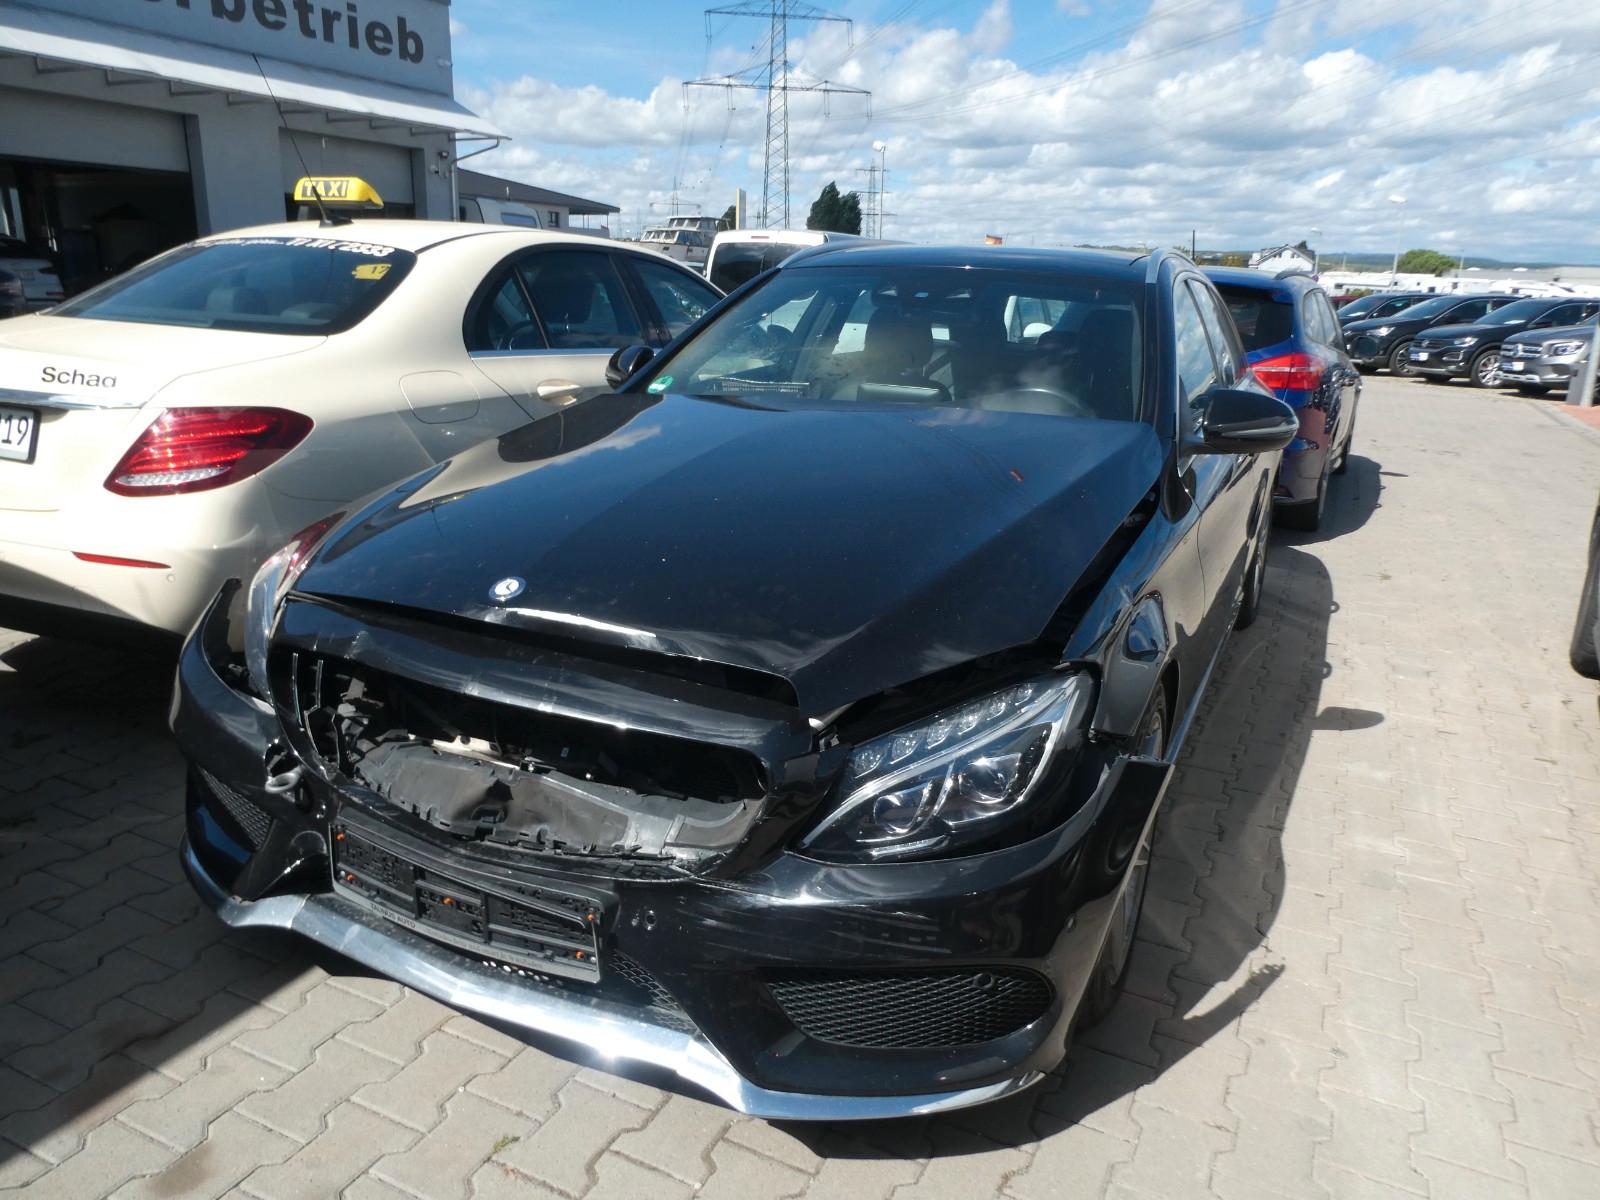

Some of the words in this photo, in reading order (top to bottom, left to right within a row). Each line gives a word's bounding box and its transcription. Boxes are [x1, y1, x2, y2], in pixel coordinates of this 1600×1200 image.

[144, 0, 424, 64] etrieb
[304, 181, 348, 197] TAXI
[0, 414, 29, 446] 19
